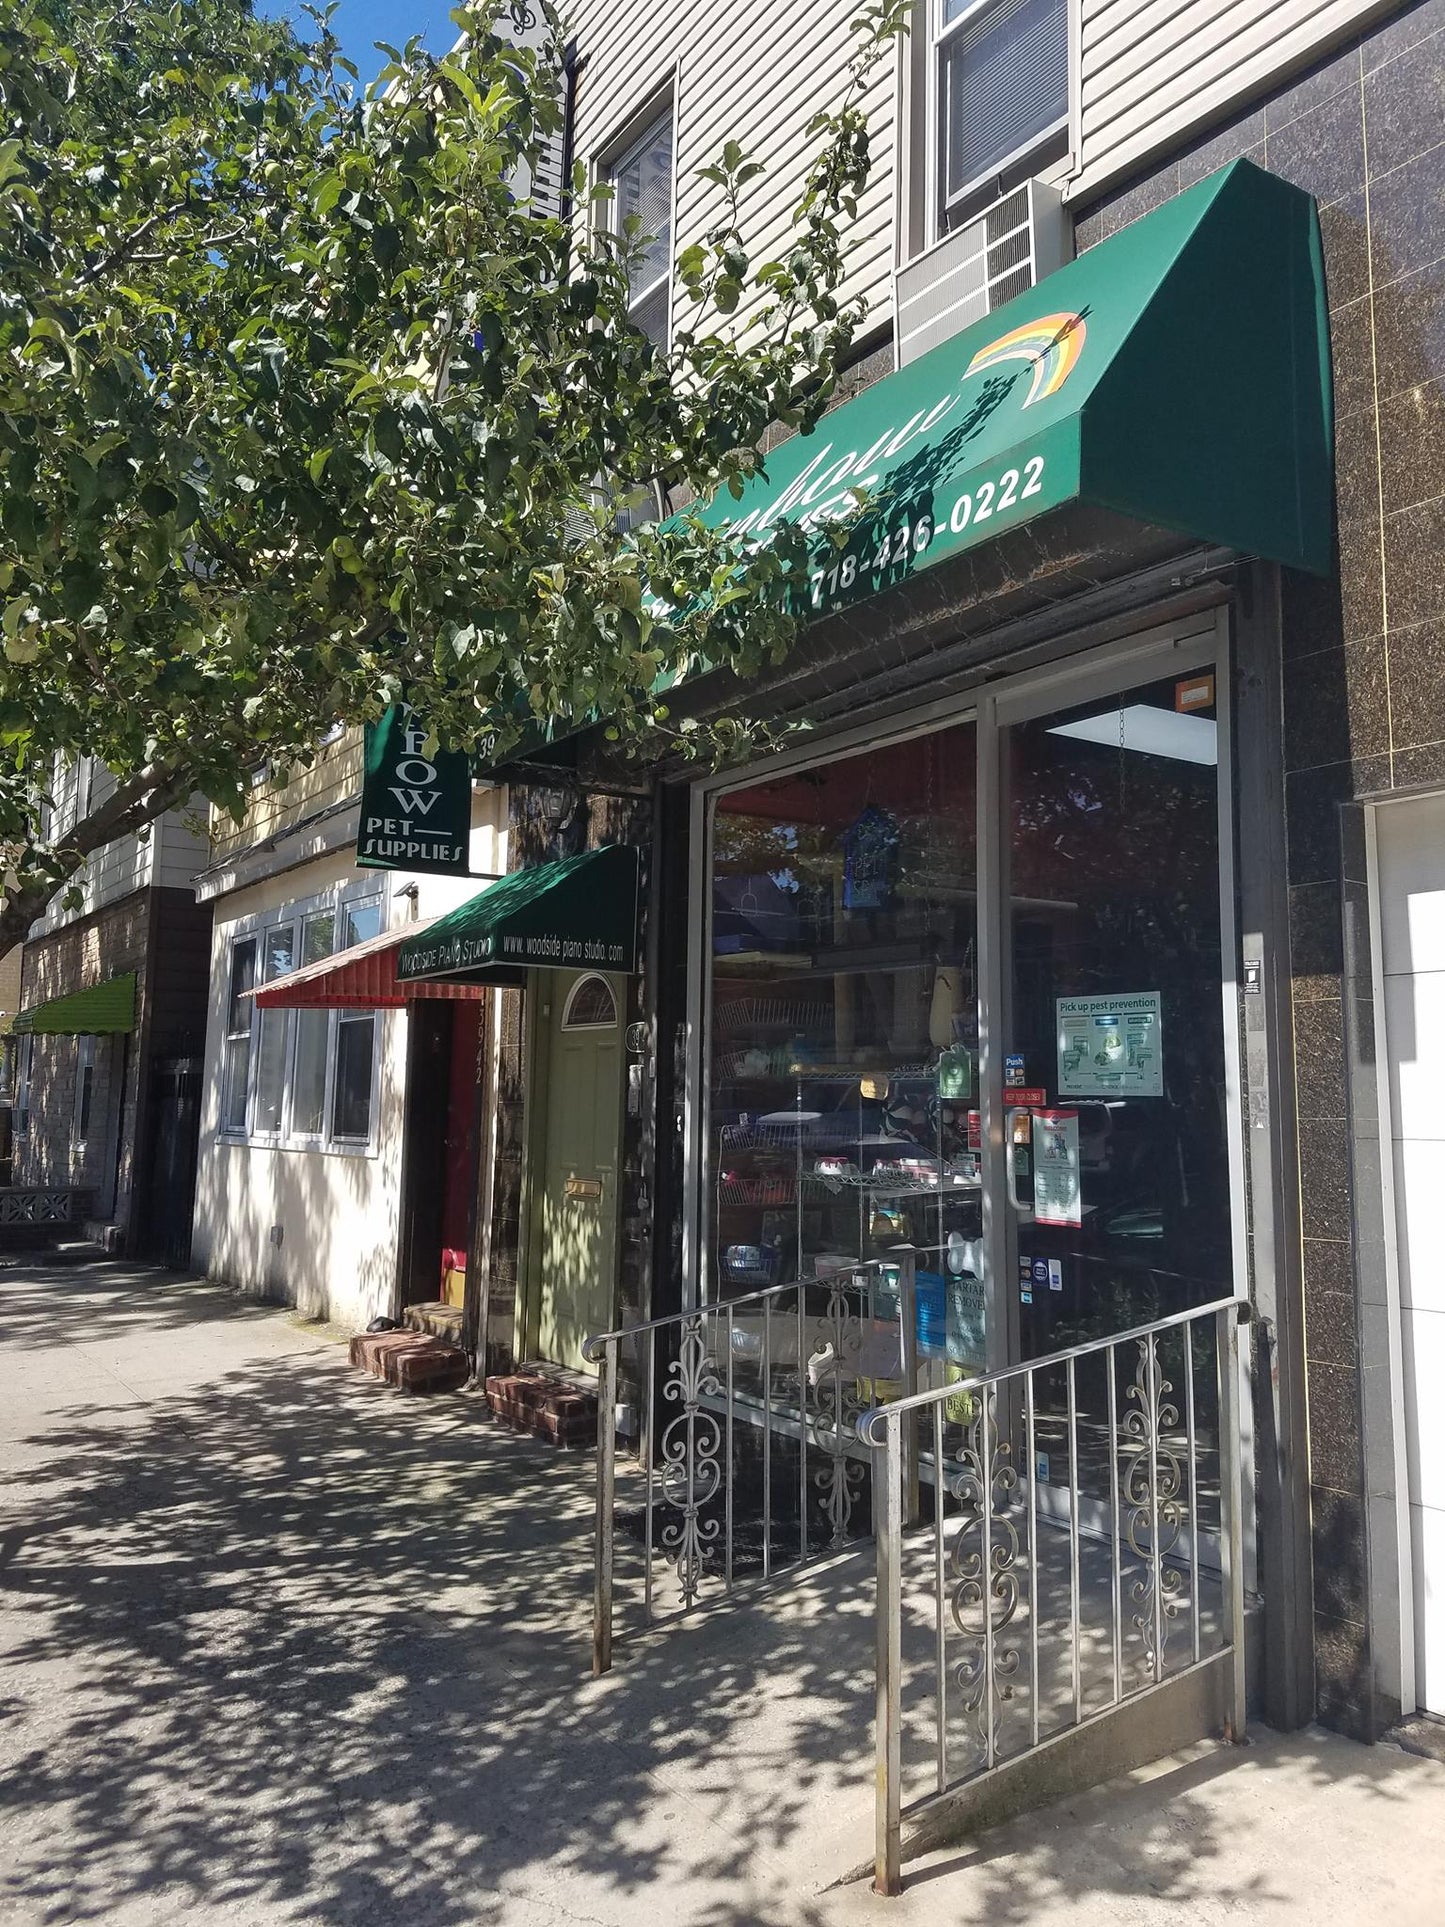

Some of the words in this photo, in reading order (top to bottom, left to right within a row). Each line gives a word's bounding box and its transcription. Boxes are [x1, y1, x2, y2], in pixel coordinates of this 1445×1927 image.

[811, 456, 1045, 606] 718-426-0222
[366, 817, 414, 836] PET
[363, 839, 463, 861] SUPPLIES
[526, 934, 561, 957] woodside
[562, 938, 583, 962] piano
[1060, 1002, 1077, 1012] Pick
[1078, 1004, 1088, 1013] up
[1090, 1001, 1108, 1012] pest
[1109, 998, 1156, 1011] prevention
[1006, 1058, 1023, 1066] Push
[948, 1292, 986, 1310] REMOVE
